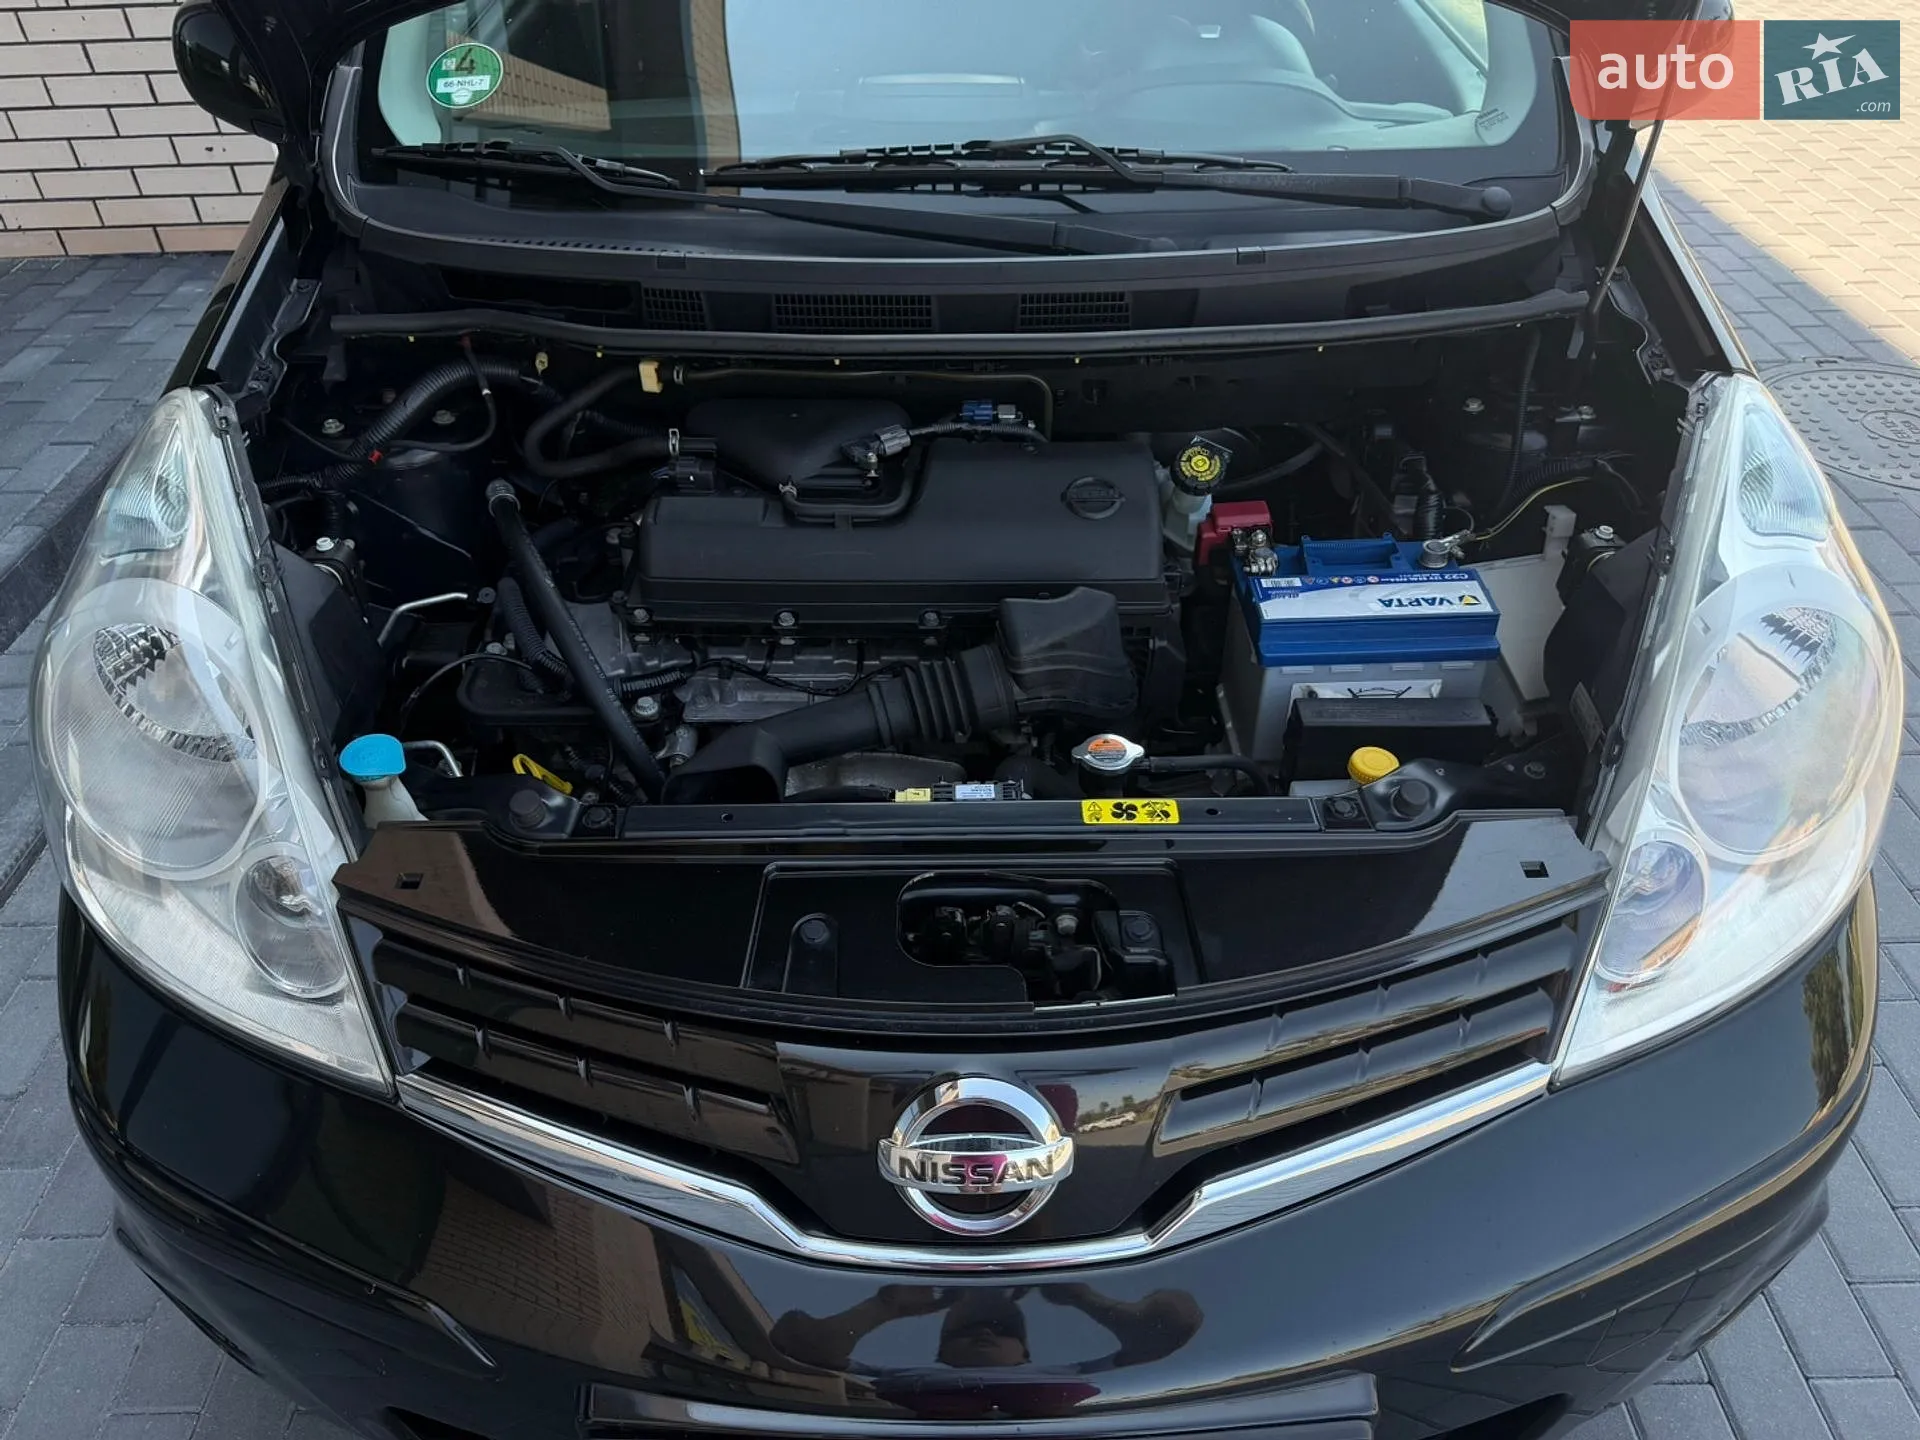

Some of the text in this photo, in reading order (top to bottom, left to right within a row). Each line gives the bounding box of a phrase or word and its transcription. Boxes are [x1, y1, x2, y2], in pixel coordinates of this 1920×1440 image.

[455, 47, 476, 74] 4
[1377, 596, 1454, 608] VARTA
[899, 1153, 1054, 1184] NISSAN
